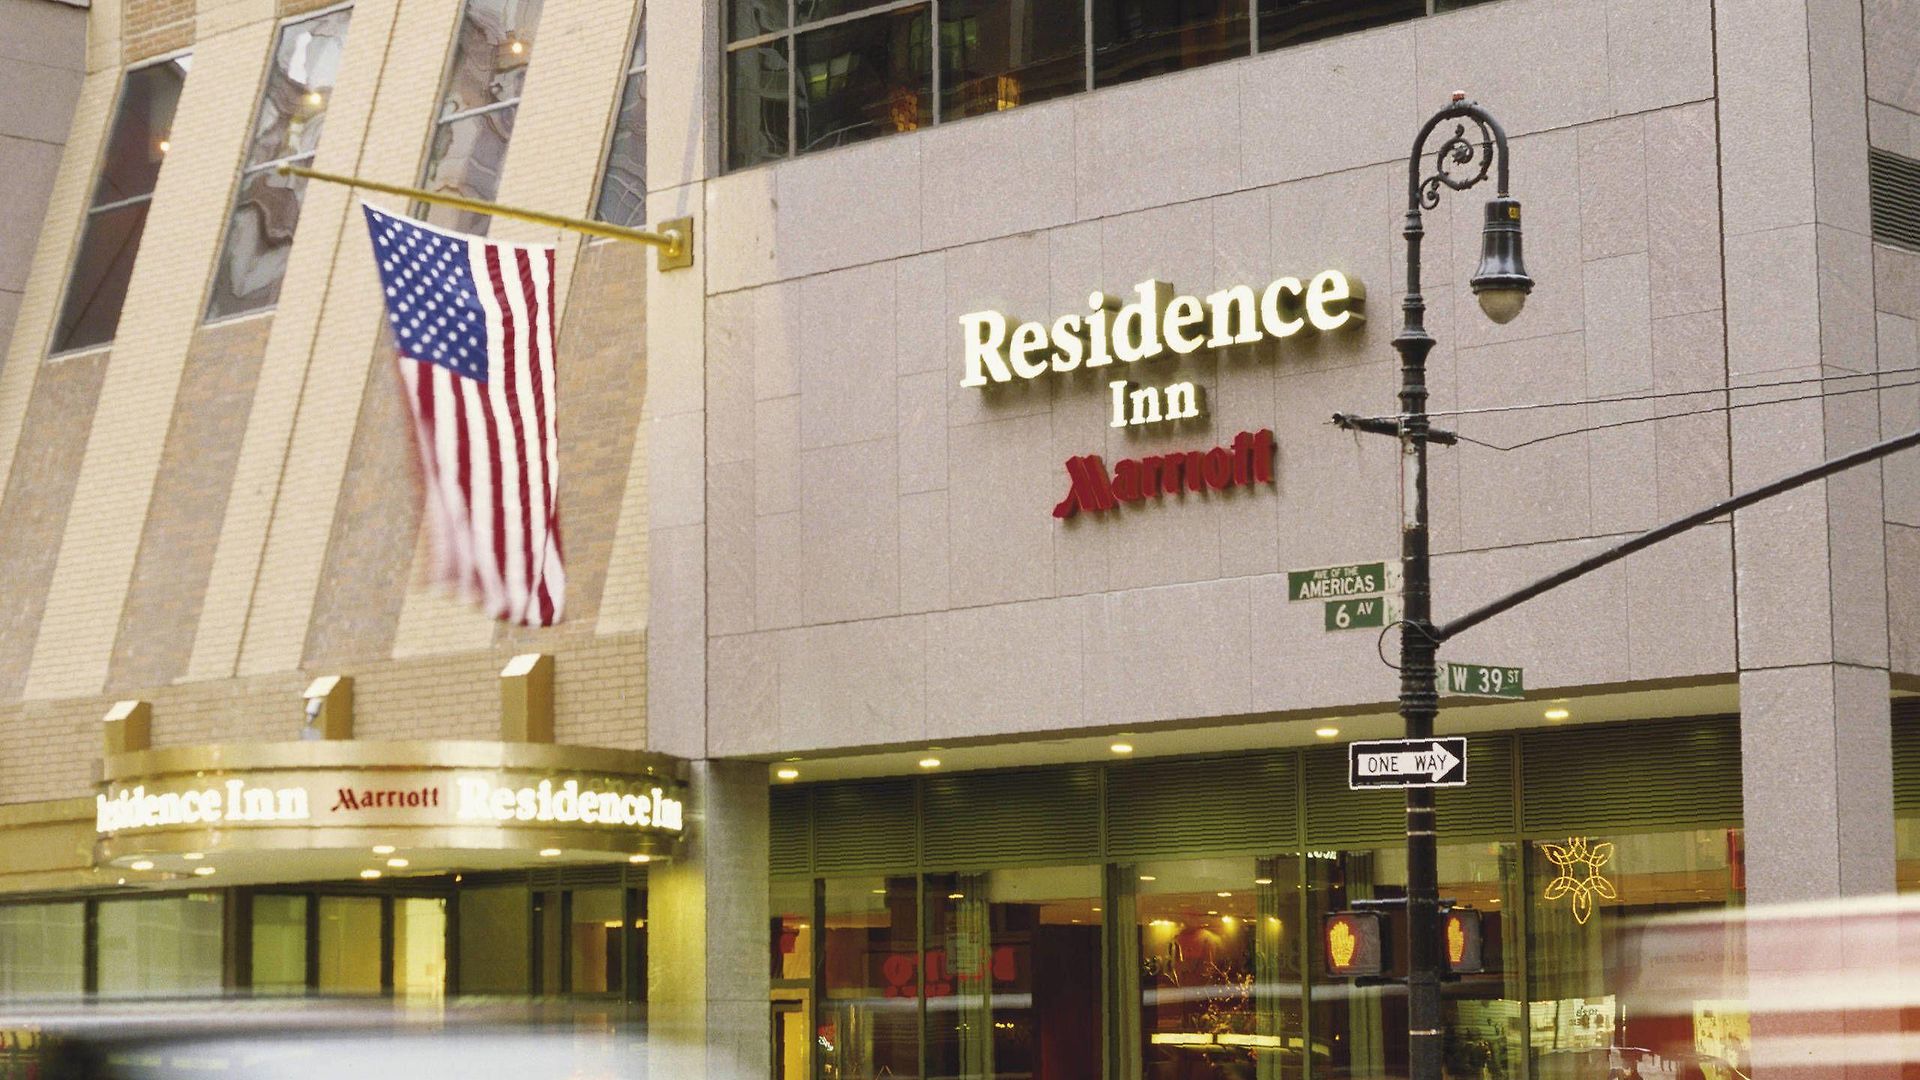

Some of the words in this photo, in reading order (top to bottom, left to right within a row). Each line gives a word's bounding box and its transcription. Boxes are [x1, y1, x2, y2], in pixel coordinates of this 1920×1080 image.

[958, 268, 1360, 388] Residence
[1109, 379, 1202, 428] Inn
[1052, 427, 1275, 518] Marriott
[1299, 574, 1375, 599] AMERICAS
[1313, 570, 1329, 580] AVE
[1330, 568, 1341, 578] OF
[1343, 566, 1359, 577] THE
[1335, 603, 1351, 628] 6
[1356, 601, 1374, 616] AV
[1452, 666, 1468, 692] W
[1478, 667, 1503, 693] 39
[1507, 669, 1520, 684] ST
[1367, 755, 1399, 774] ONE
[1414, 753, 1447, 772] WAY
[95, 785, 222, 834] idence
[224, 779, 311, 821] Inn
[330, 786, 439, 812] Marriott
[457, 777, 651, 826] Residence
